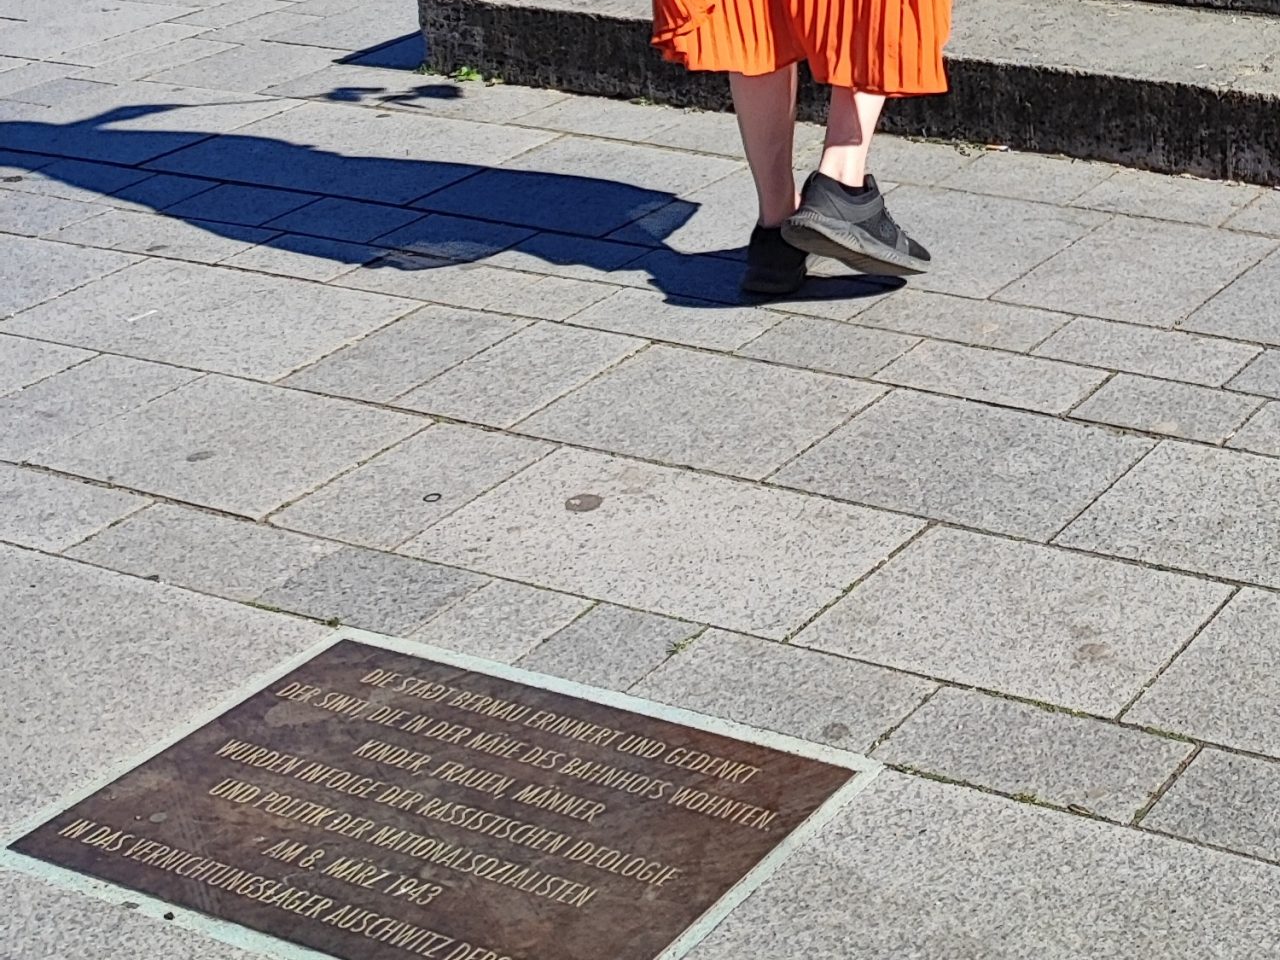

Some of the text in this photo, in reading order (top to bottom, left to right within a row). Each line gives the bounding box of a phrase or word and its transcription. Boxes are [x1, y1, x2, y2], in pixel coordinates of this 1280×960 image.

[275, 682, 778, 832] DER SINTI, DIE IN DER NÄHE DES BAHNHOFS WOHNTEN.
[352, 739, 607, 823] KINDER, FRAUEN, MÄNNER
[360, 668, 761, 784] DIE STADT BERNAU ERINNERT UND GEDENKT
[209, 778, 598, 908] UND POLITIK DER NATIONALSOZIALISTEN
[215, 739, 684, 888] WURDEN INFOLGE DER RASSISTISCHEN IDEOLOGIE
[261, 839, 442, 905] AM 8. MÄRZ 1943
[58, 818, 90, 838] IN
[82, 826, 135, 851] DAS
[122, 838, 336, 919] VERNICHTUNGSLAGER
[322, 905, 455, 959] AUSCHWITZ
